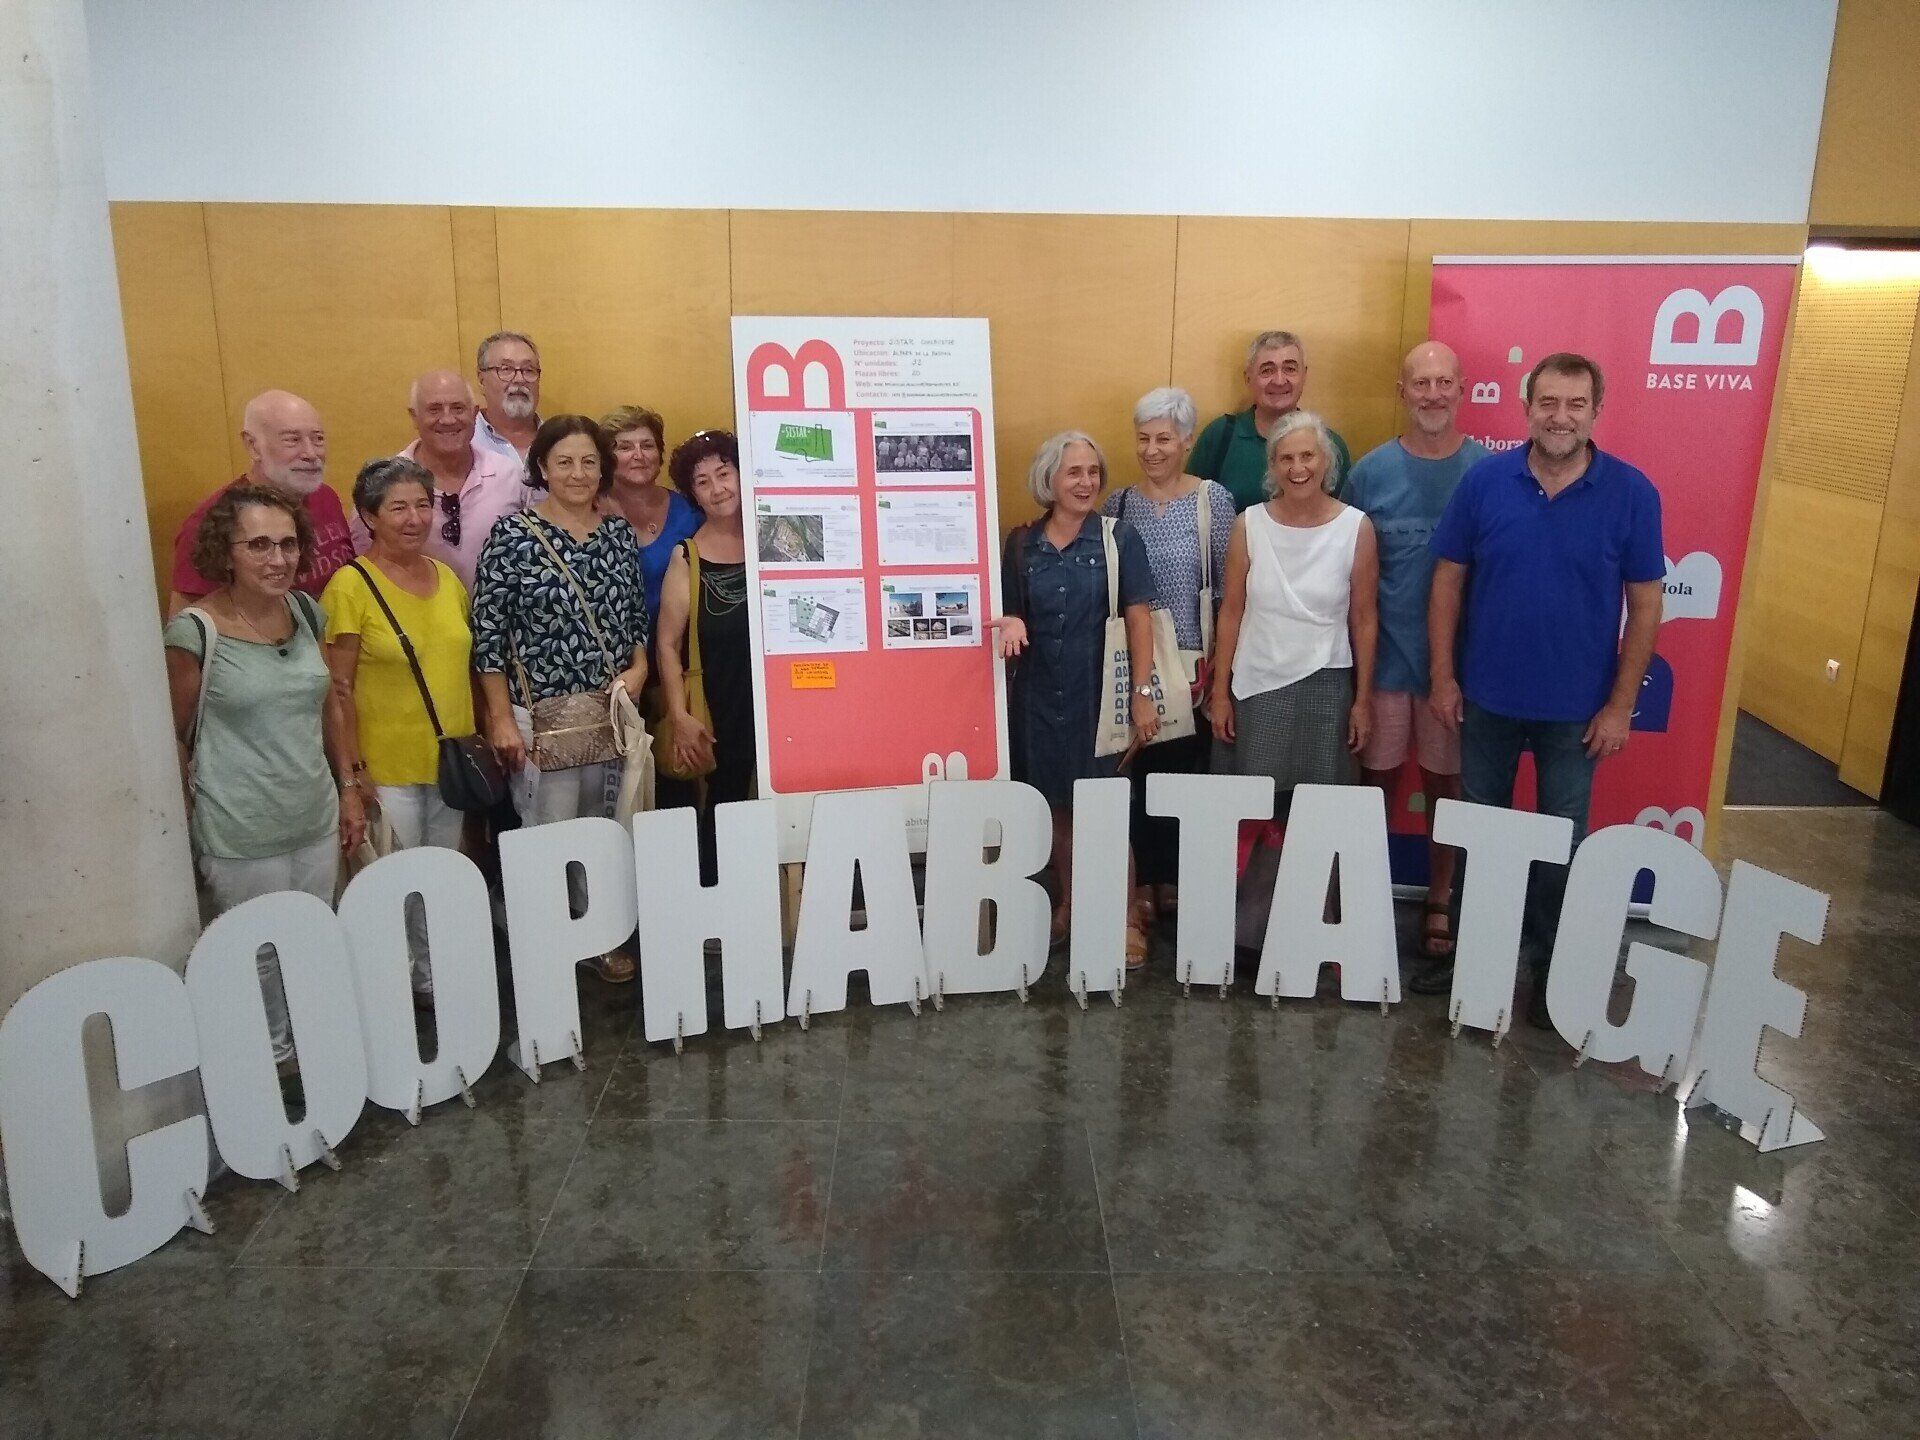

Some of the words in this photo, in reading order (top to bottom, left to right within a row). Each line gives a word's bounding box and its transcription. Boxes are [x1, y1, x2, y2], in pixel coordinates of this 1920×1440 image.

[1646, 373, 1697, 390] BASE
[1705, 374, 1753, 391] VIVA
[0, 773, 1830, 1290] COOPHABITATGE
